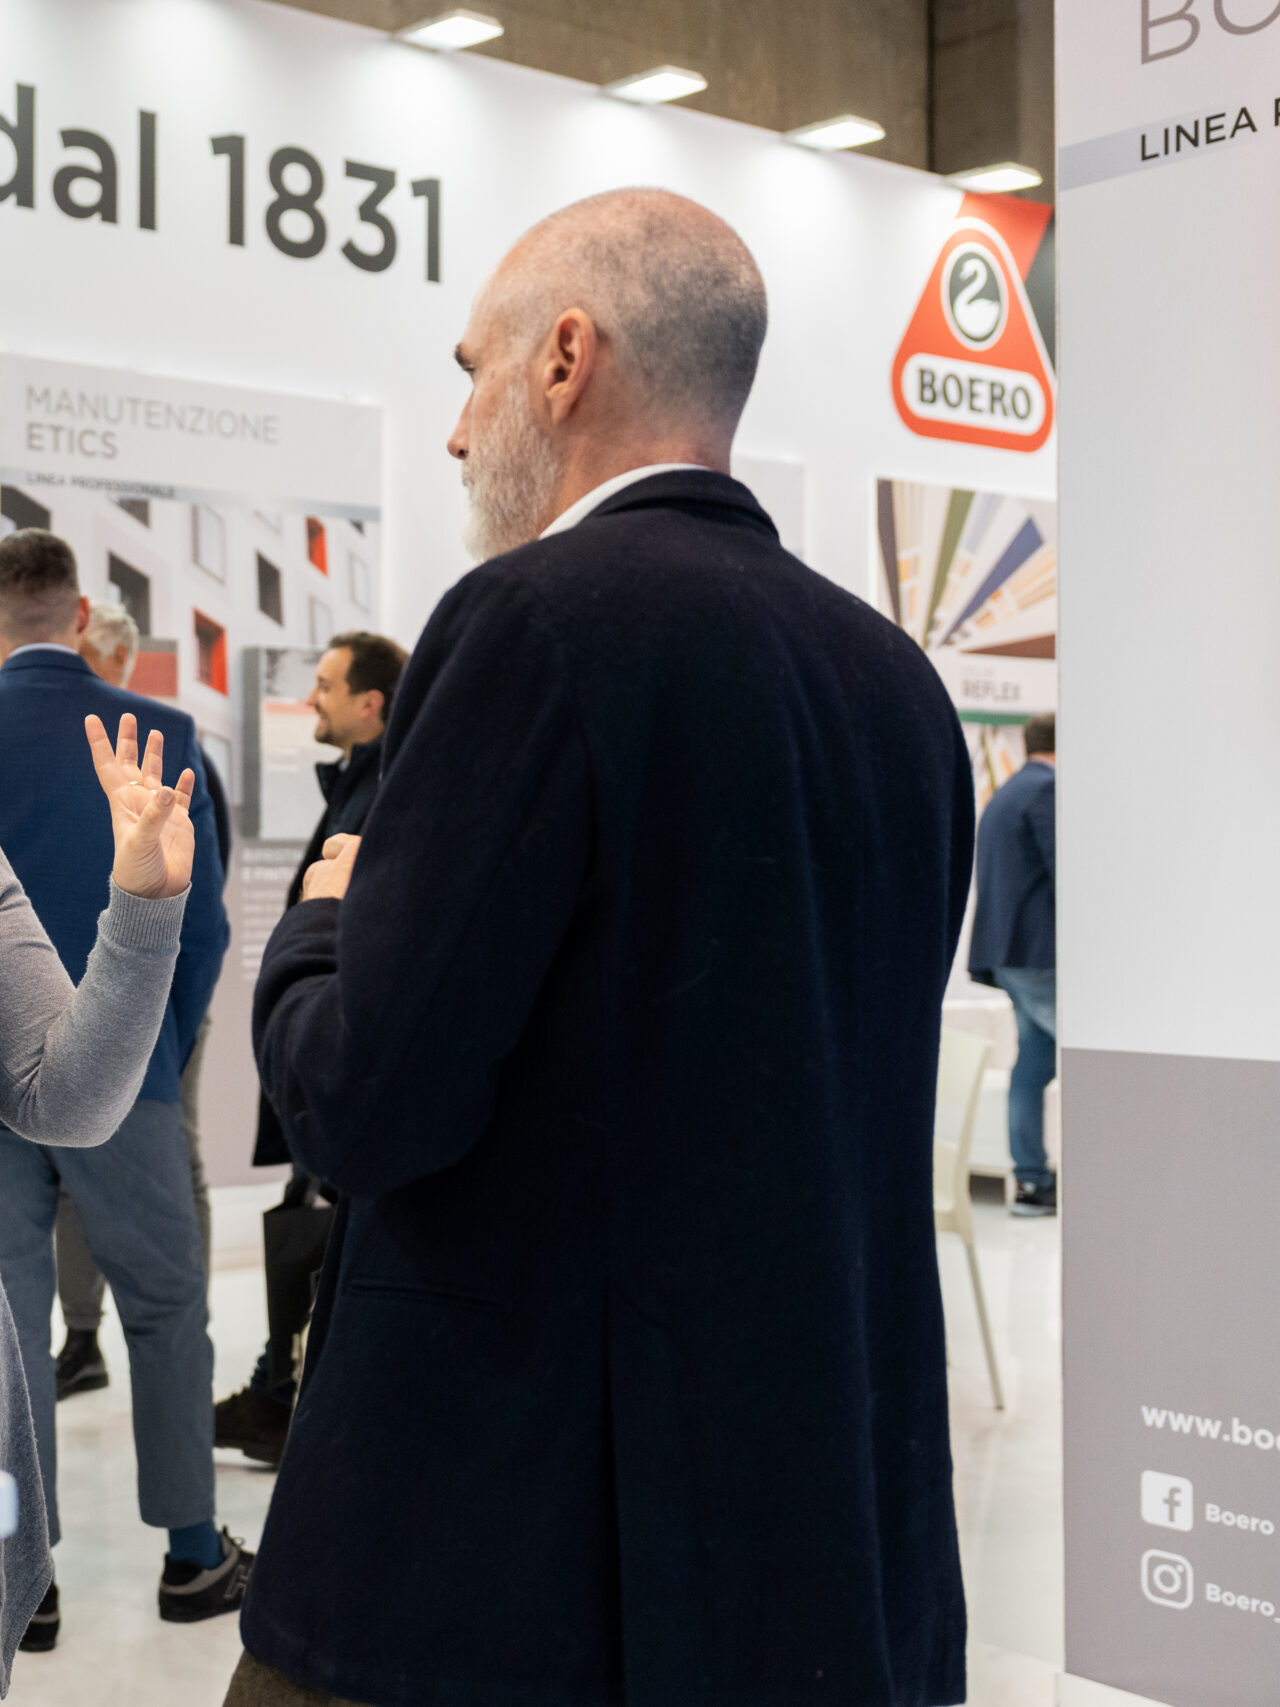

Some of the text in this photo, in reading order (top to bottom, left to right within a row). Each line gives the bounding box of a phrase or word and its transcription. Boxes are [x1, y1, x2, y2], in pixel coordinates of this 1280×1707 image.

[1141, 107, 1257, 162] LINEA
[210, 132, 441, 283] 1831
[25, 385, 280, 445] MANUTENZIONE
[917, 367, 1032, 421] BOERO
[26, 422, 118, 460] ETICS
[1140, 1405, 1280, 1451] www.bo
[1205, 1503, 1275, 1535] Boero
